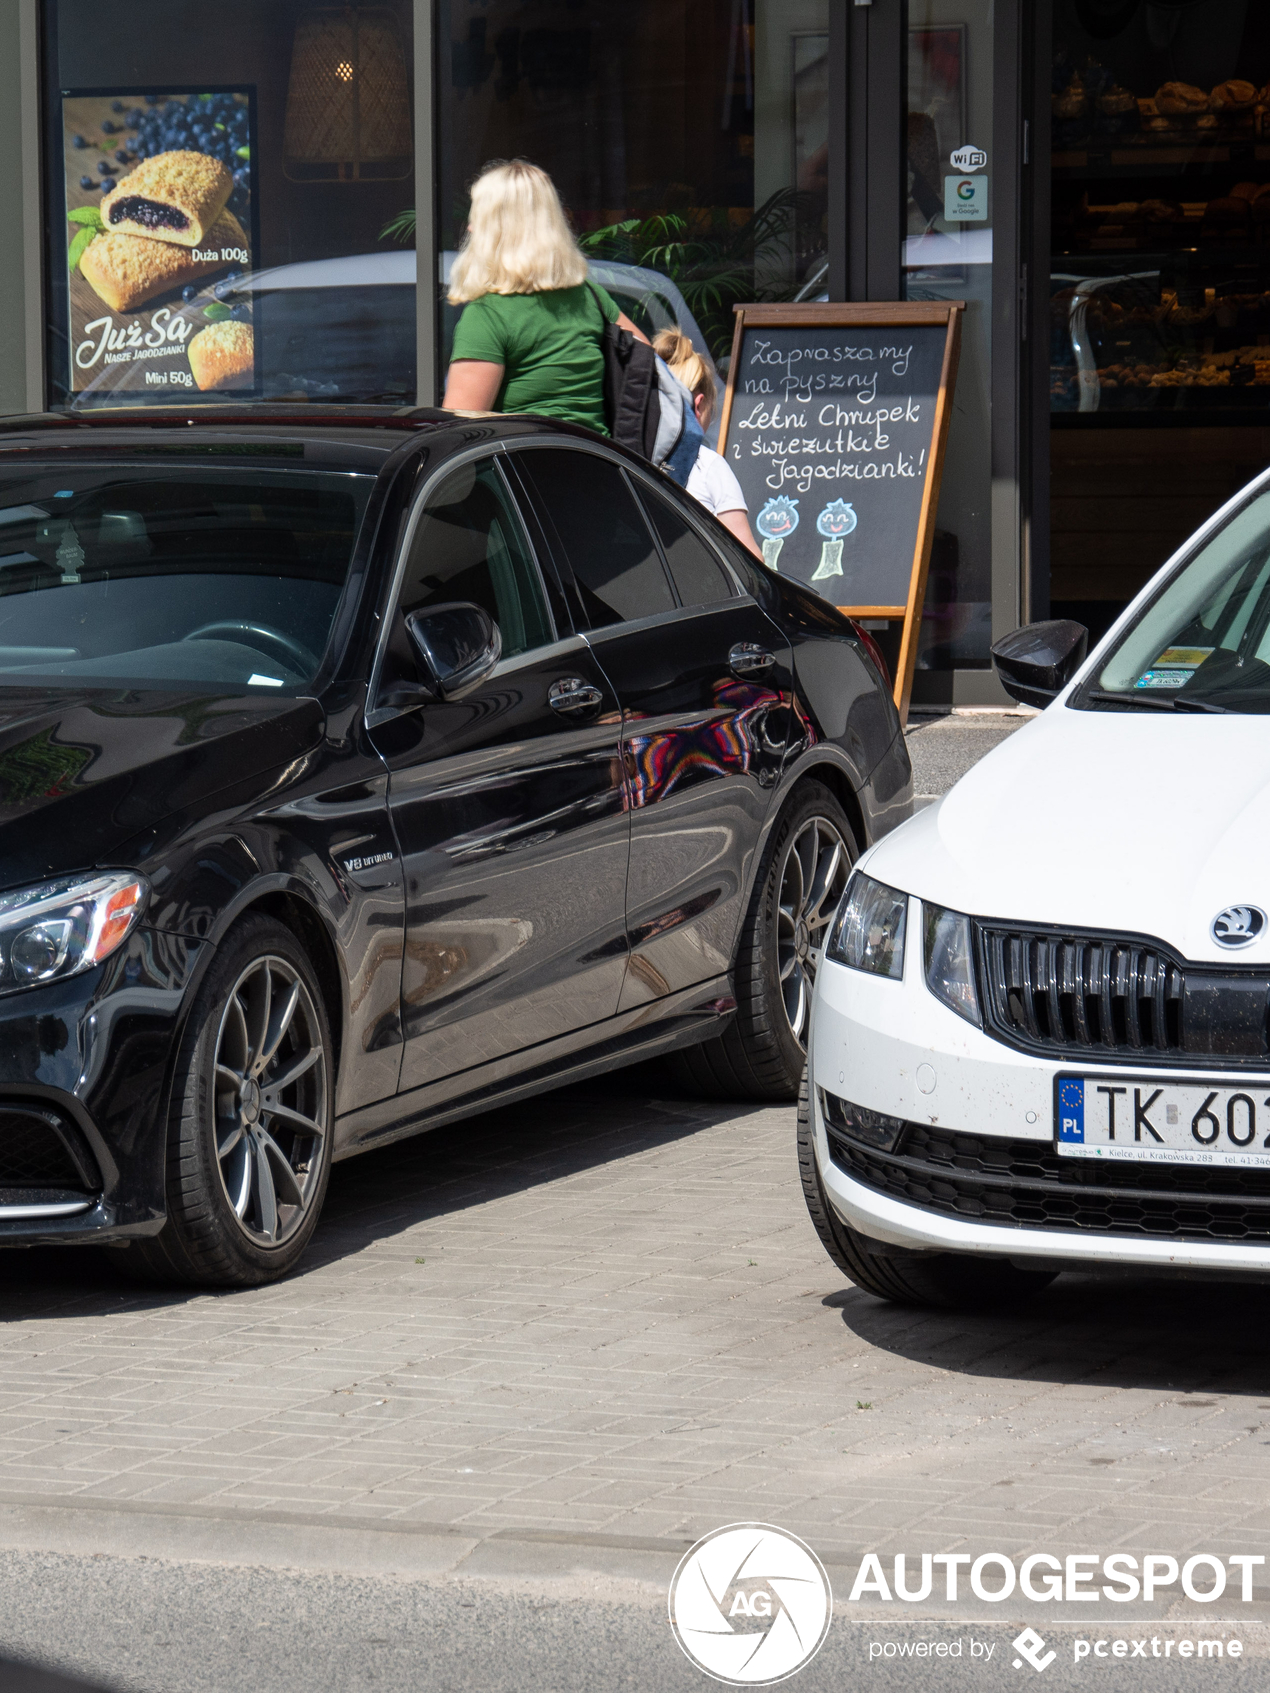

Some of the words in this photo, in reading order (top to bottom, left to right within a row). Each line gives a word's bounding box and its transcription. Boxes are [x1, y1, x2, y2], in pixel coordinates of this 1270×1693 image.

[958, 207, 980, 216] Google
[191, 249, 219, 262] Duża
[221, 248, 248, 263] 100g
[75, 316, 143, 369] Już
[750, 340, 914, 376] Zapraszamy
[145, 372, 168, 384] Mini
[169, 371, 193, 387] 50g
[744, 380, 774, 394] na
[780, 372, 878, 404] pyszny
[738, 402, 808, 429] Letni
[818, 396, 921, 438] Chrupek
[766, 448, 925, 493] Jagodzianki!
[1063, 1118, 1081, 1134] PL
[1096, 1086, 1165, 1143] TK
[1191, 1091, 1270, 1148] 60
[1109, 1149, 1135, 1158] Kielce,
[1149, 1152, 1195, 1162] Krakowska
